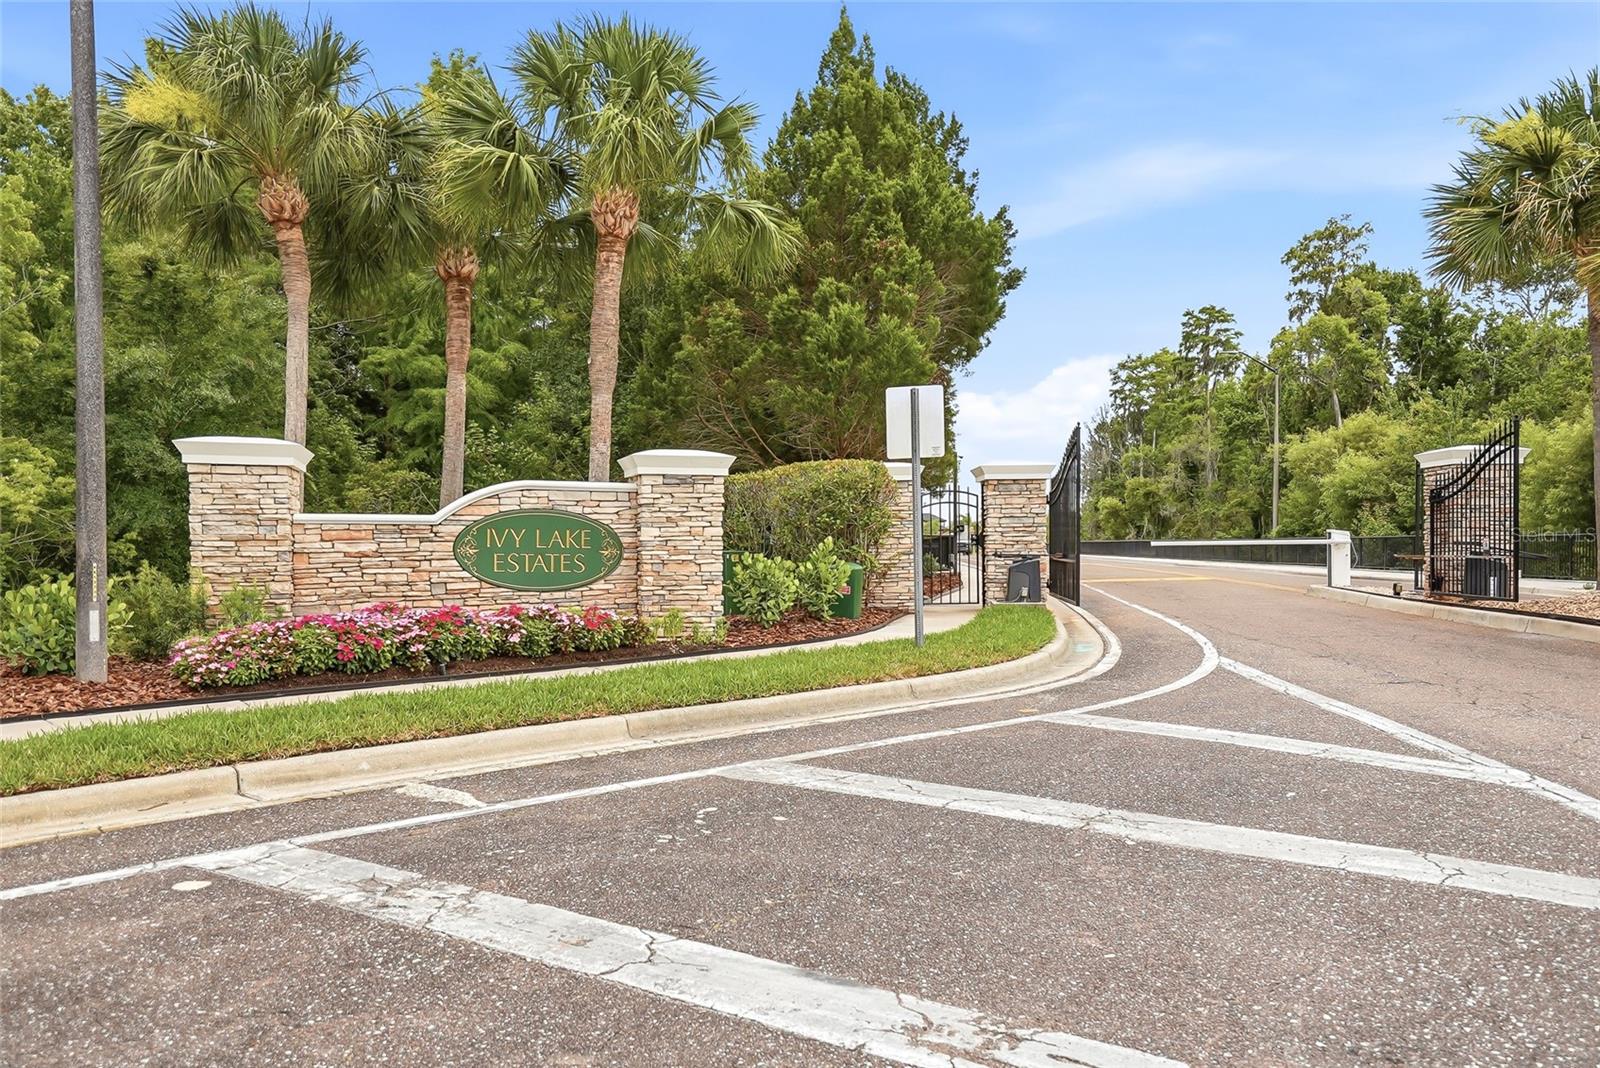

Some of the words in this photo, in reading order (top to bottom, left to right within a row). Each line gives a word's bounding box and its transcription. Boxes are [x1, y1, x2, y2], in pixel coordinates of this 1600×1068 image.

[486, 528, 527, 549] IVY
[535, 528, 592, 549] LAKE
[493, 552, 586, 574] ESTATES
